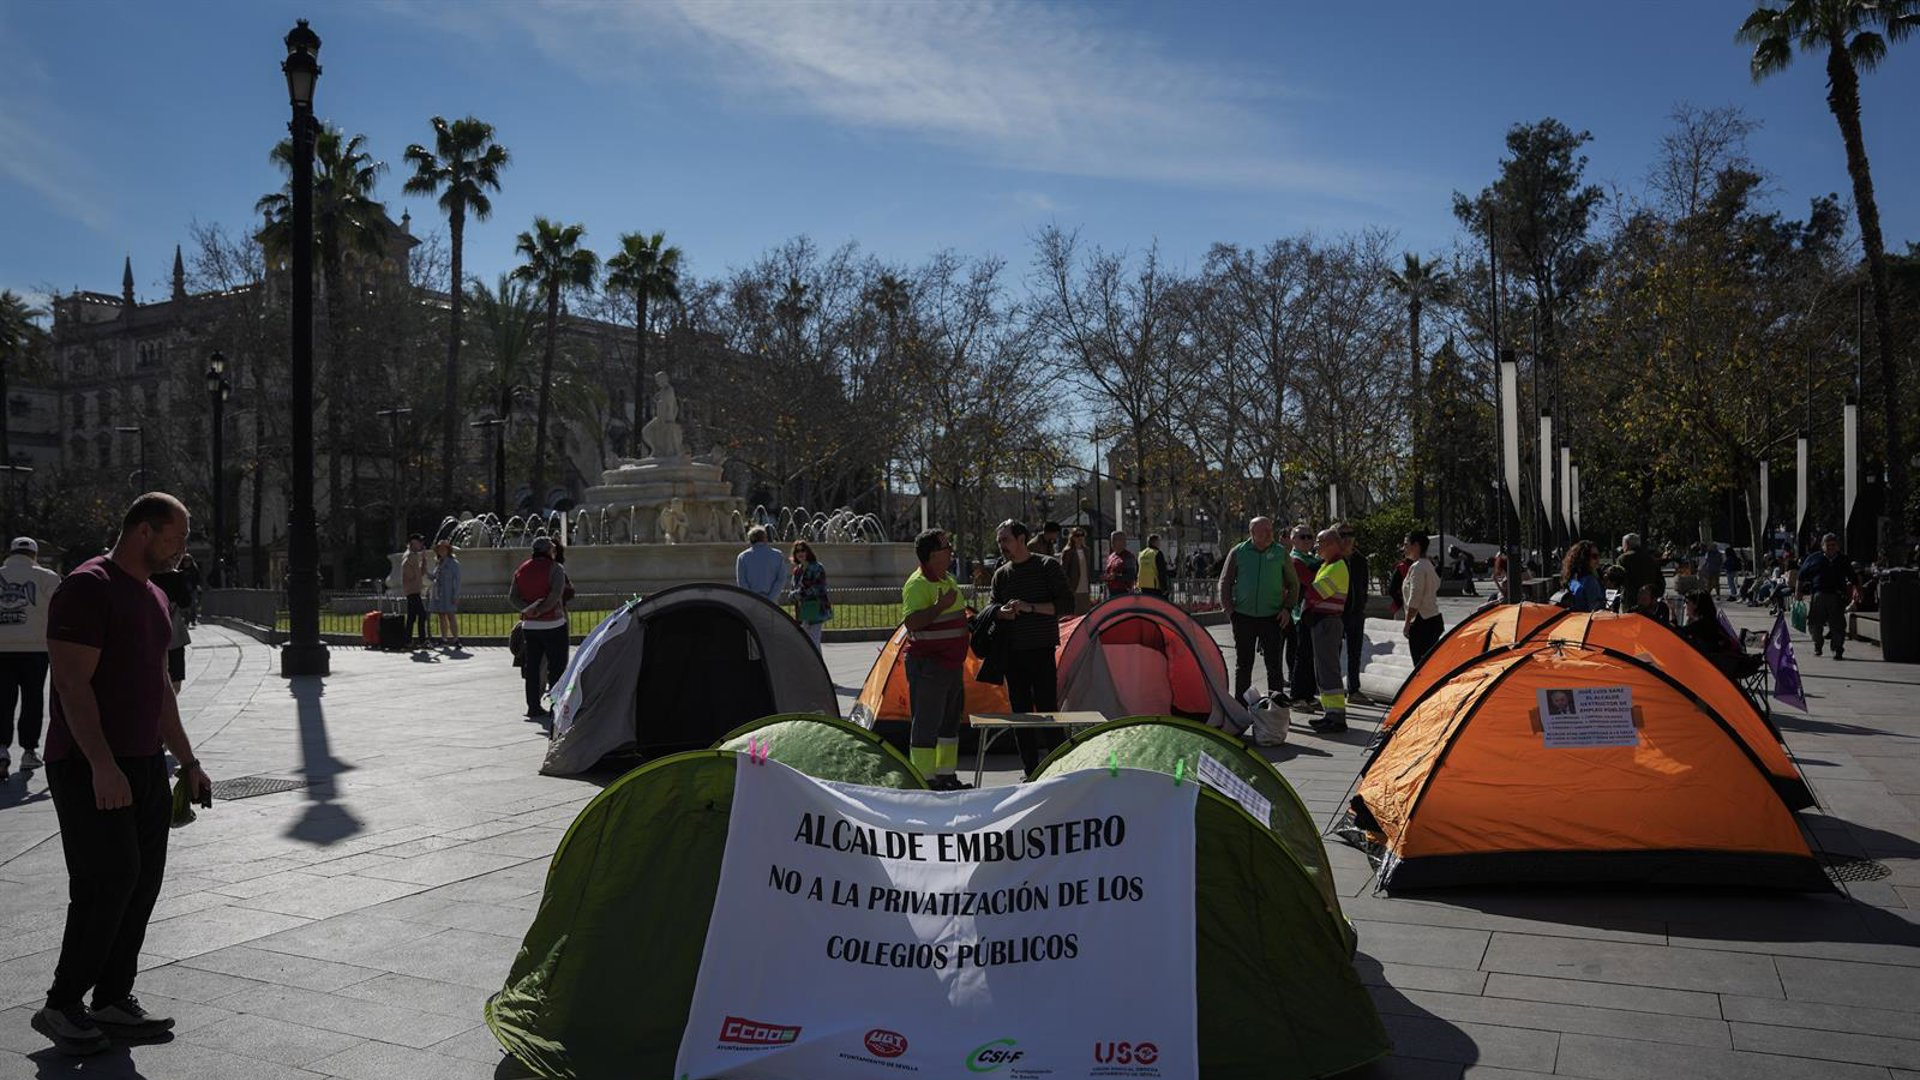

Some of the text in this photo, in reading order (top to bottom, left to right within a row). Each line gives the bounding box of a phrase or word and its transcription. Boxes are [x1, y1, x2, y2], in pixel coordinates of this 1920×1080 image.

[794, 812, 1126, 862] ALCALDE EMBUSTERO
[768, 864, 1144, 917] NO A LA PRIVATIZACIÓN DE LOS
[826, 933, 1078, 970] COLEGIOS PÚBLICOS
[868, 1031, 904, 1049] UGT
[1095, 1042, 1158, 1065] USO
